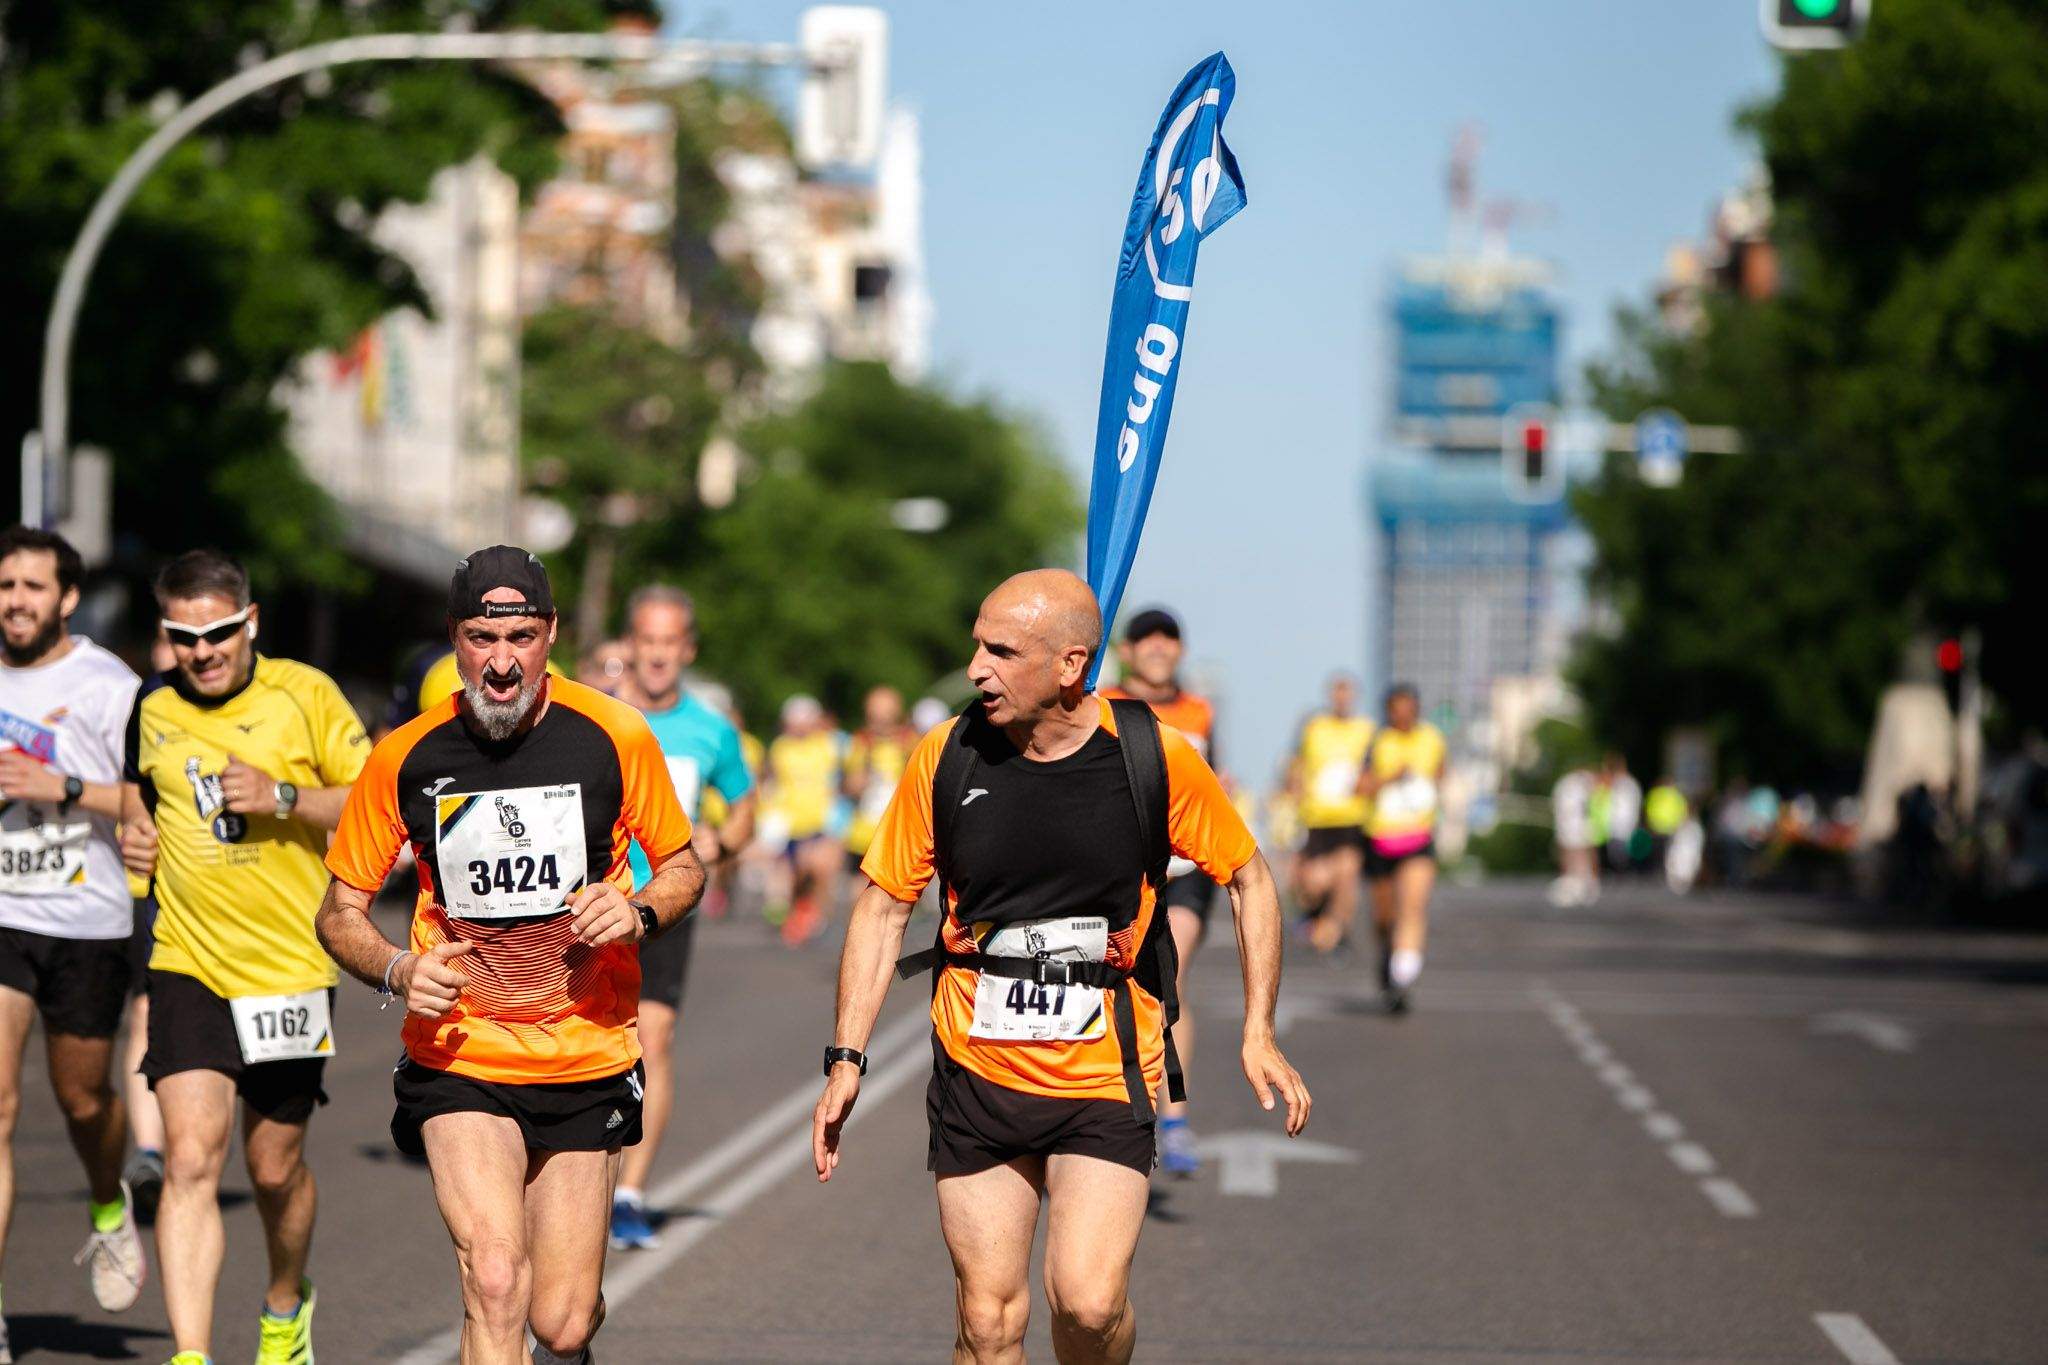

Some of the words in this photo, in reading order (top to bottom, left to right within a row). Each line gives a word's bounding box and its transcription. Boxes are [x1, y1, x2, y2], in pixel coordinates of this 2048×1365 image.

[1161, 157, 1221, 246] 50
[510, 824, 523, 835] 13
[468, 854, 561, 896] 3424
[1006, 980, 1066, 1015] 447
[251, 1007, 309, 1040] 1762
